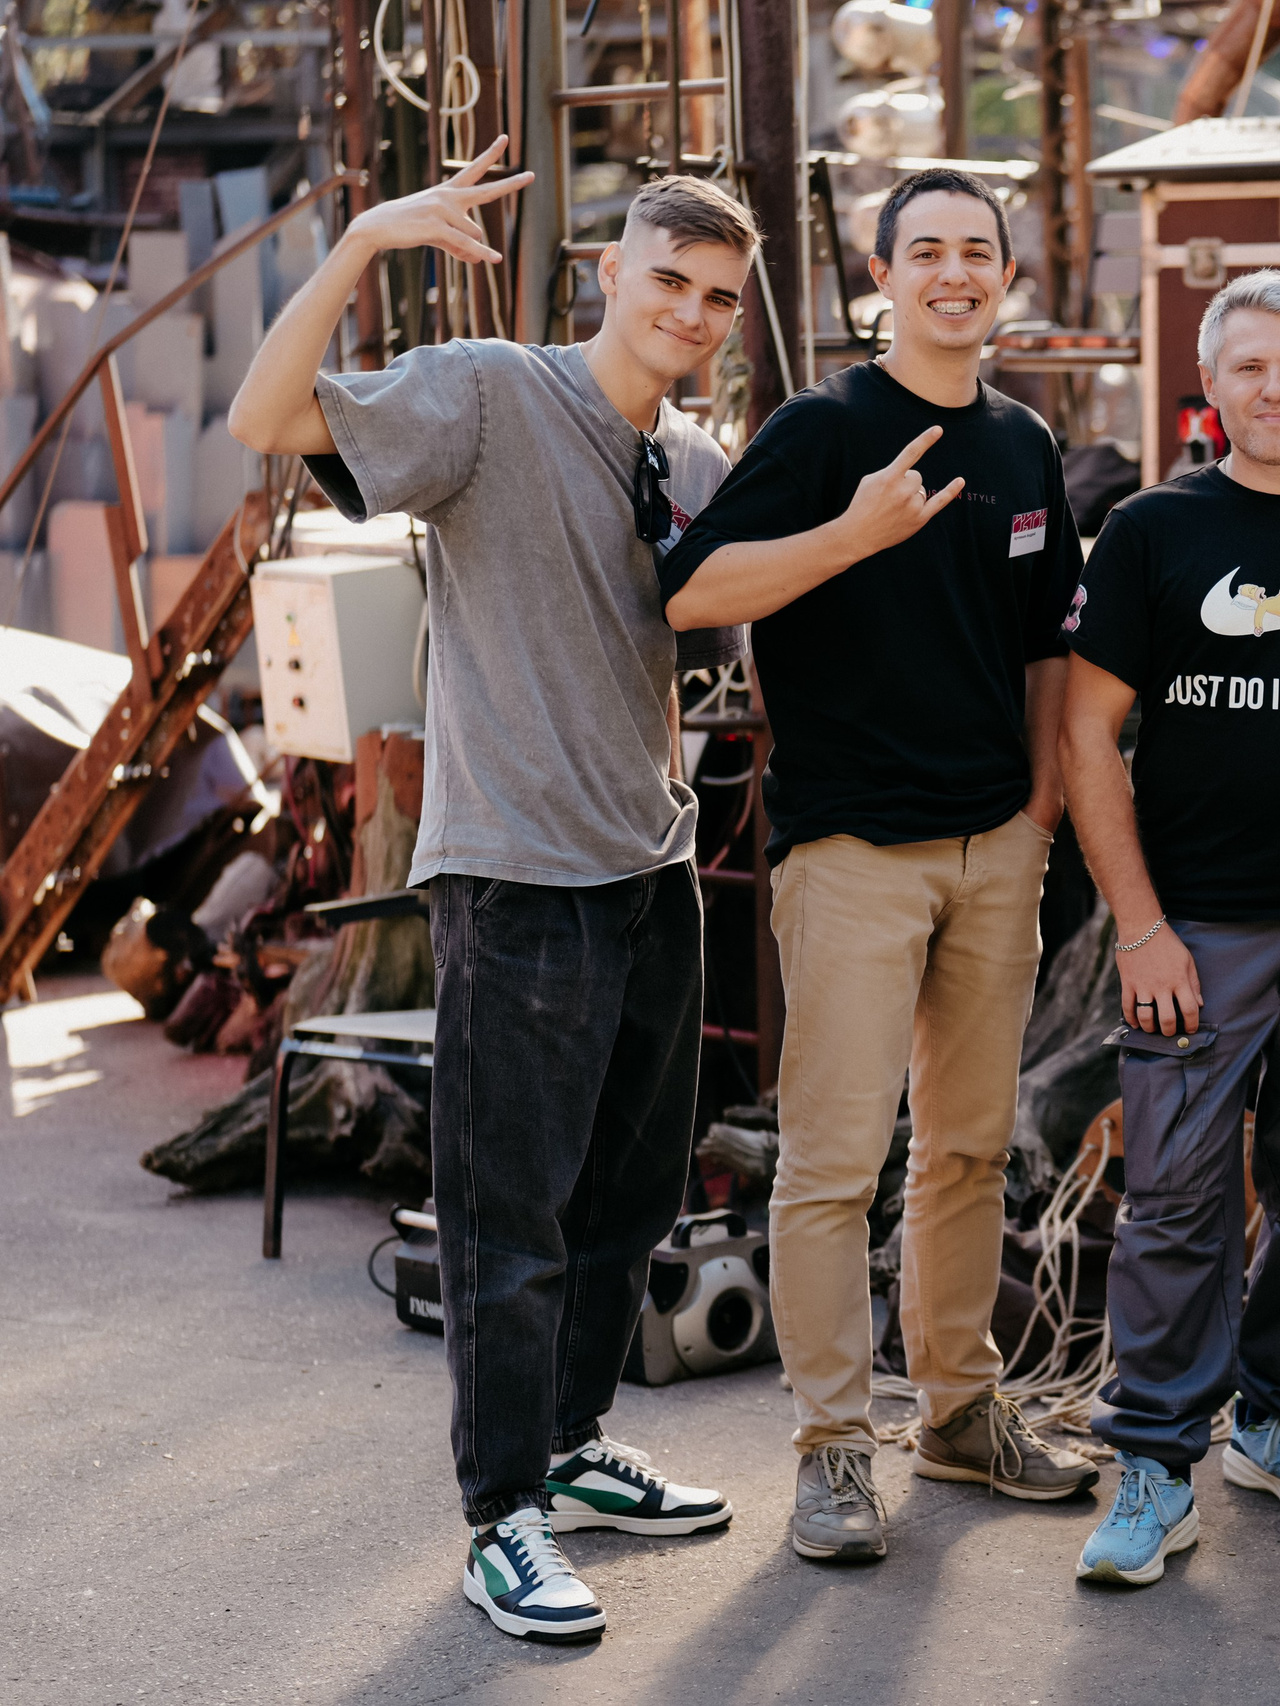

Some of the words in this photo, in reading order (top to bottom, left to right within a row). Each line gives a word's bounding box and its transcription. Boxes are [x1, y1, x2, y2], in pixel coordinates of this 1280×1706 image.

[967, 492, 996, 505] STYLE
[1164, 674, 1224, 708] JUST
[1228, 676, 1265, 710] DO
